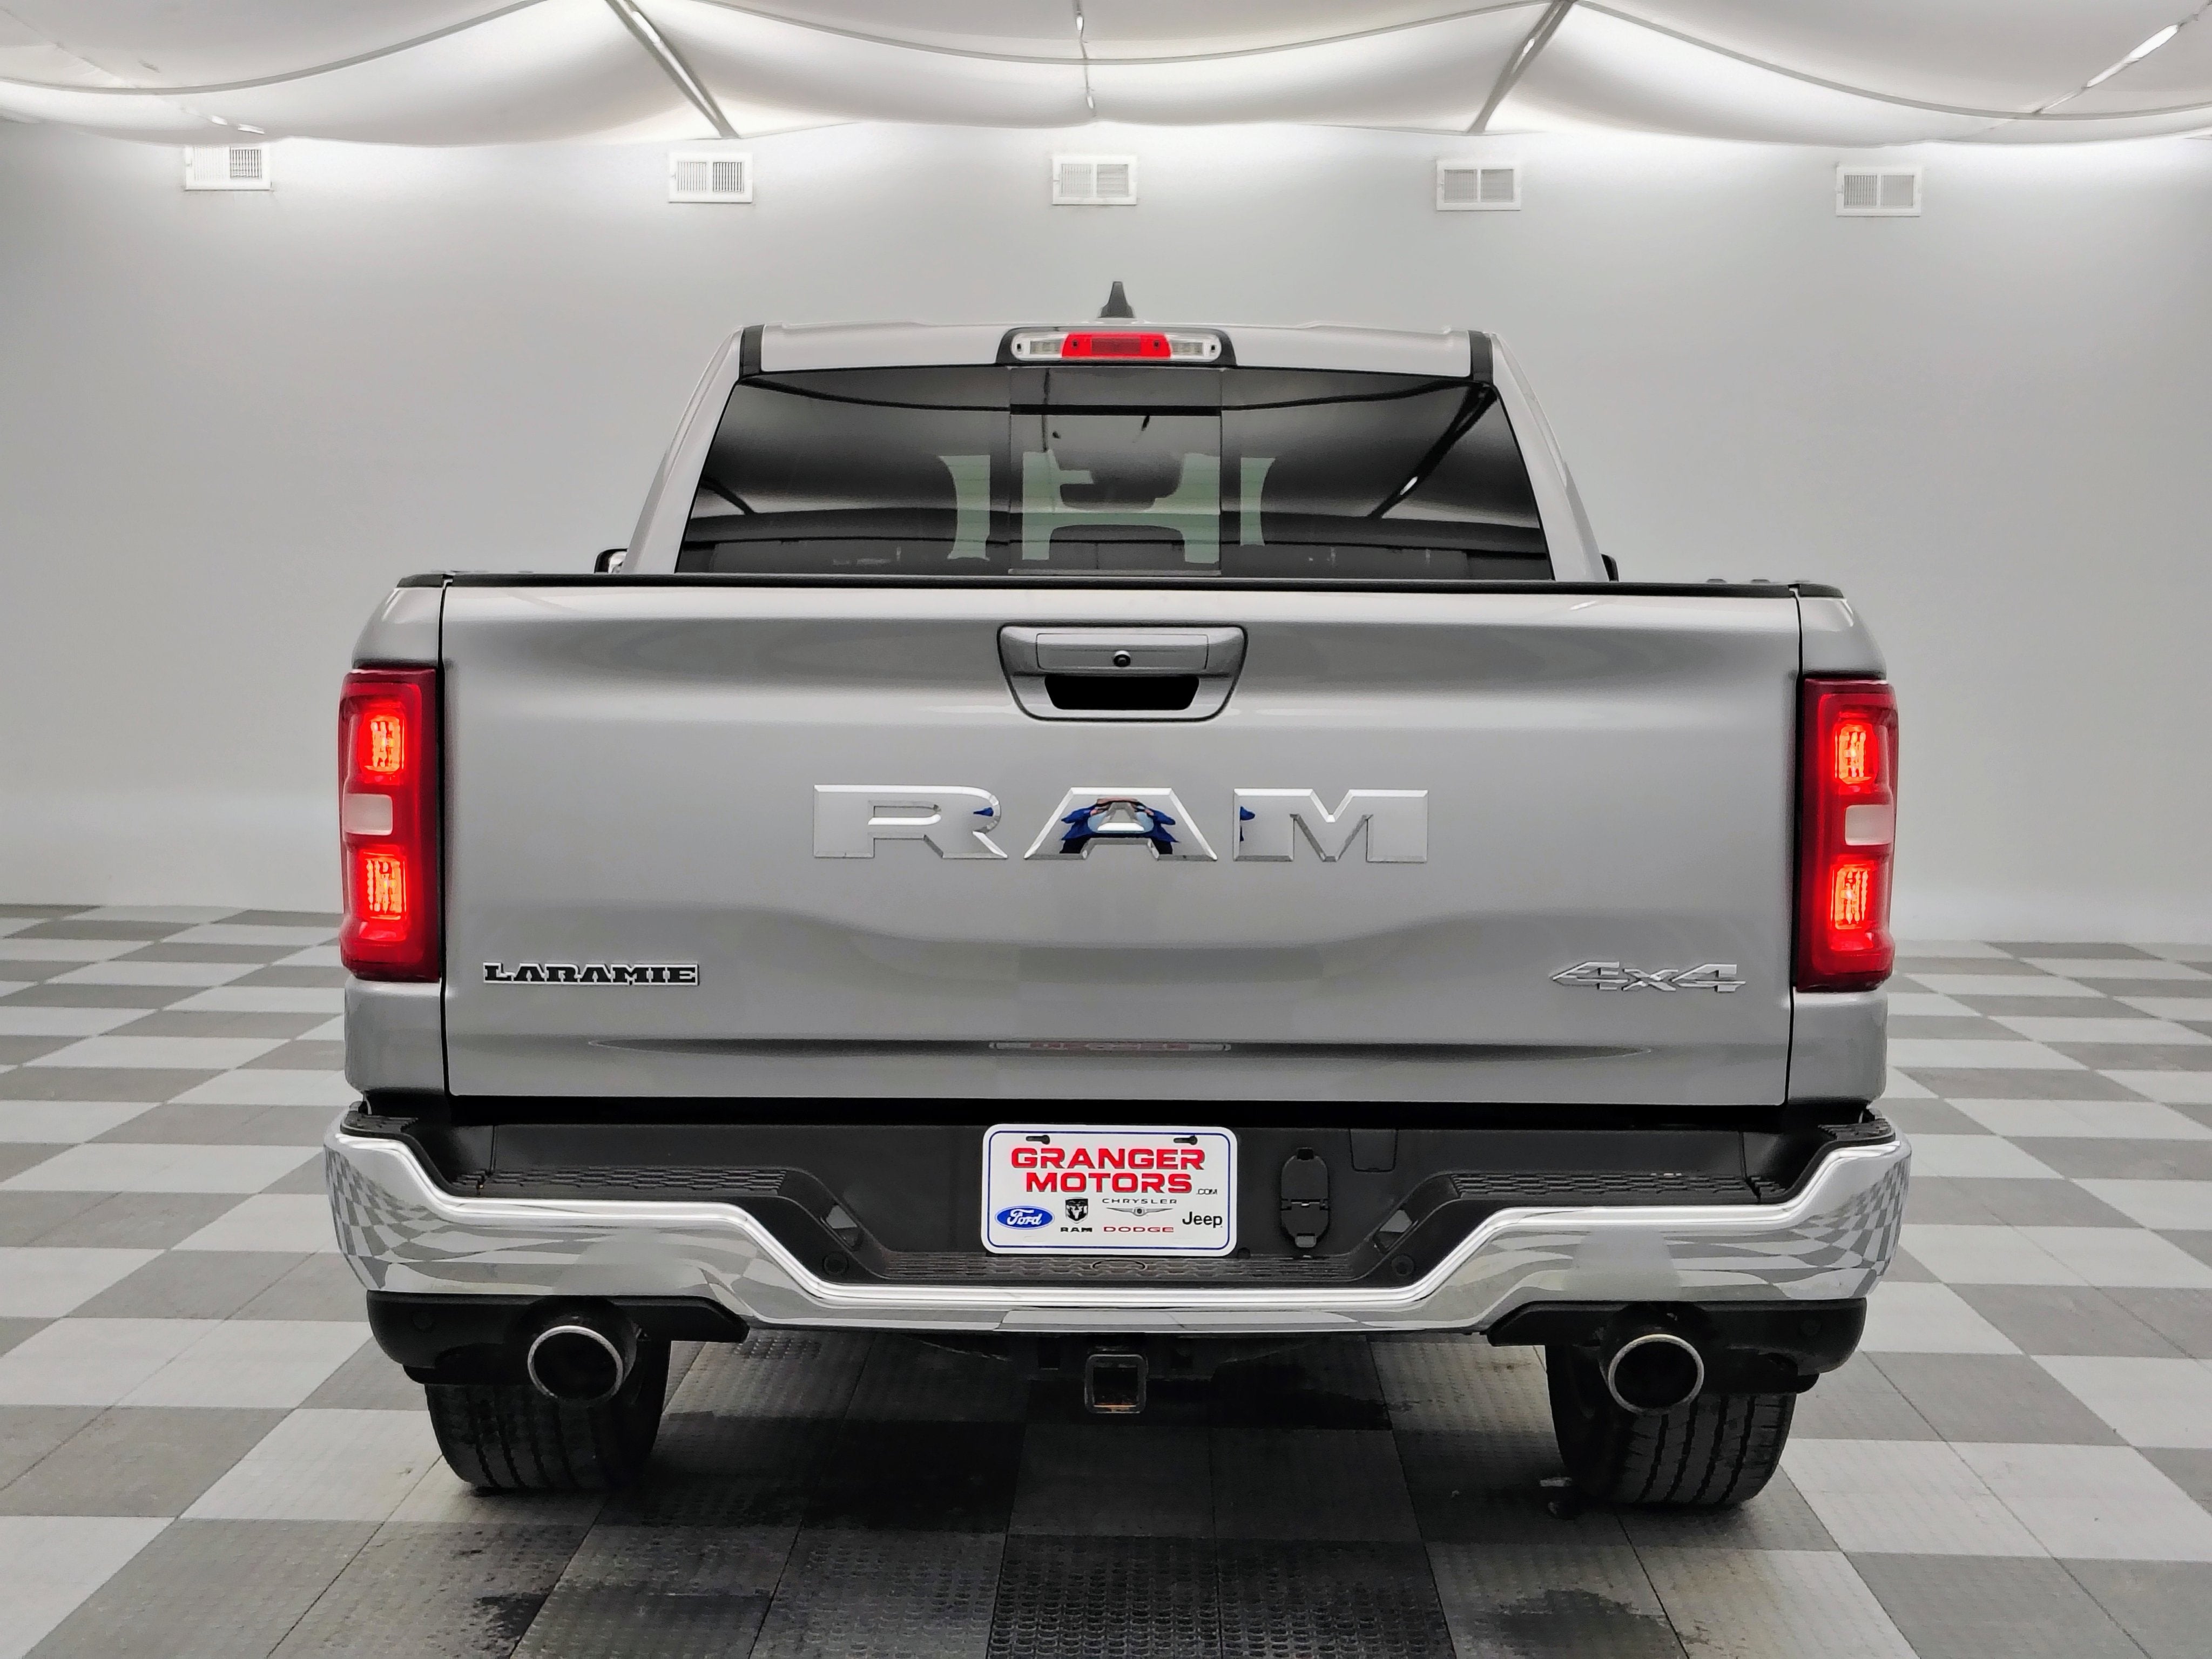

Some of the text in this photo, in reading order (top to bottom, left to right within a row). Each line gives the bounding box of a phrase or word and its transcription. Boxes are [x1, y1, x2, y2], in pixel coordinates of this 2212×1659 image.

[813, 784, 1429, 863] RAM
[483, 962, 699, 986] LARAMIE
[1011, 1148, 1205, 1170] GRANGER
[1026, 1172, 1192, 1194] MOTORS
[1007, 1209, 1043, 1226] Ford
[1182, 1211, 1223, 1228] Jeep
